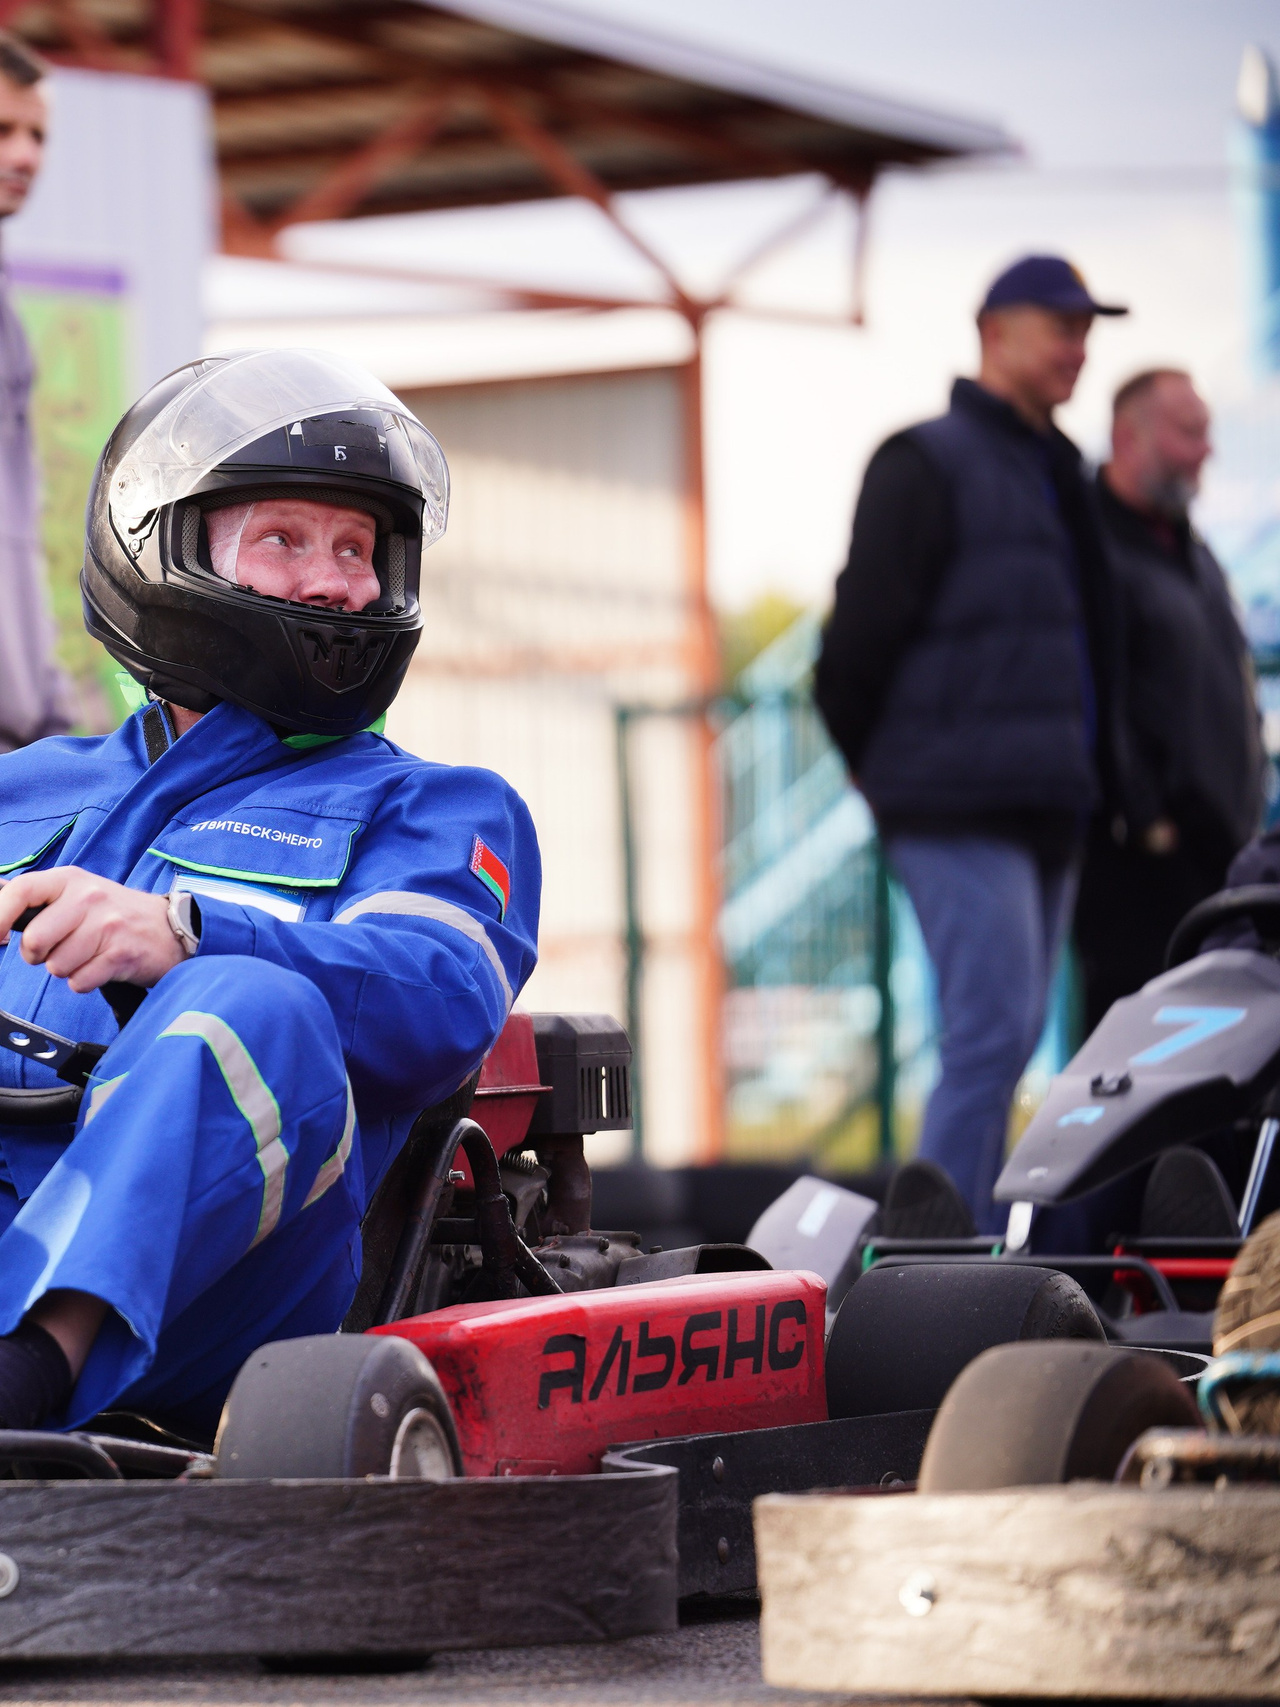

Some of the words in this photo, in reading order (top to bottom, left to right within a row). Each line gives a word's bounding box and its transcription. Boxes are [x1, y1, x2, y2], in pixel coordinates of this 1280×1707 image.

[207, 820, 323, 849] ВИТЕБСКЭНЕРГО
[1127, 1006, 1248, 1067] 7
[537, 1299, 807, 1410] АЛЬЯНС
